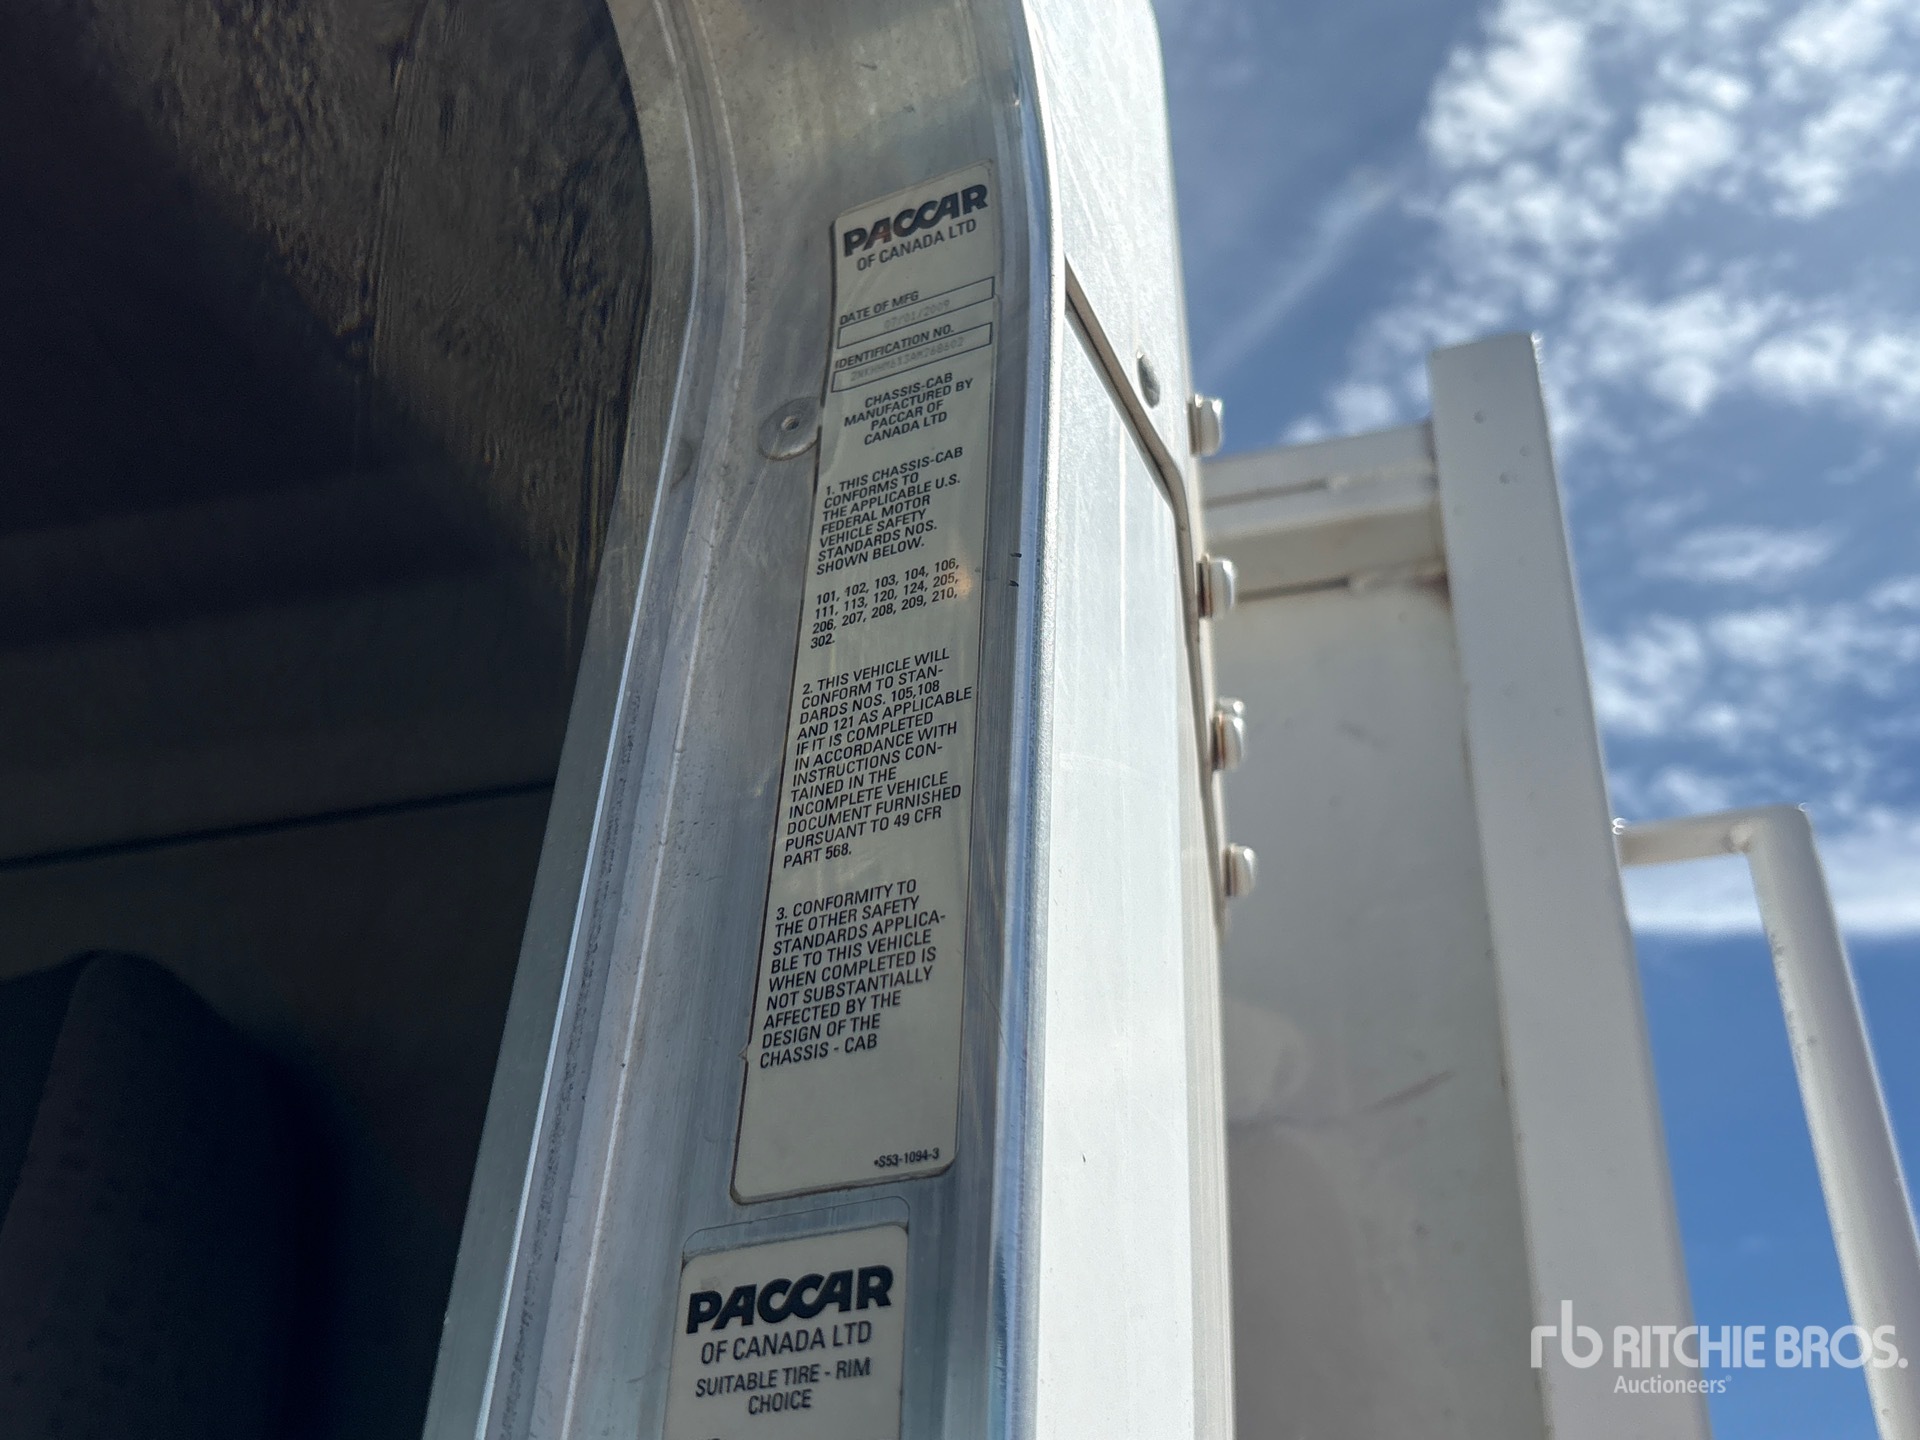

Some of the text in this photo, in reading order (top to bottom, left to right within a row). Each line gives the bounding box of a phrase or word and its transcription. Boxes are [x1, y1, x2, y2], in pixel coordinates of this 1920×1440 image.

[843, 184, 988, 258] PACCAR
[857, 219, 977, 271] OF CANADA LTD
[840, 291, 919, 325] DATE OF MFG
[835, 324, 954, 369] IDENTIFICATION NO.
[844, 378, 974, 427] MANUFACTURED BY
[865, 372, 953, 408] CHASSIS-CAB
[864, 411, 947, 446] CANADA LTD
[870, 399, 945, 431] PACCAR OF
[824, 472, 920, 509] CONFORMS TO
[826, 447, 963, 496] 1. THIS CHASSIS-CAB
[820, 495, 931, 535] FEDERAL MOTOR
[822, 473, 960, 522] THE APPLICABLE U.S.
[818, 520, 938, 562] STANDARDS NOS.
[820, 508, 927, 548] VEHICLE SAFETY
[816, 536, 925, 575] SHOWN BELOW.
[815, 572, 959, 619] 111, 113, 120, 124, 205,
[816, 558, 959, 605] 101, 102, 103, 104, 106,
[812, 586, 958, 634] 206, 207, 208, 209, 210,
[810, 634, 835, 650] 302.
[802, 648, 949, 695] 2. THIS VEHICLE WILL
[802, 665, 943, 709] CONFORM TO STAN-
[797, 687, 972, 740] AND 121 AS APPLICABLE
[800, 680, 940, 724] DARDS NOS. 105,108
[795, 721, 957, 771] IN ACCORDANCE WITH
[796, 712, 933, 756] IF IT IS COMPLETED
[791, 766, 897, 802] TAINED IN THE
[793, 741, 943, 787] INSTRUCTIONS CON-
[787, 784, 961, 835] DOCUMENT FURNISHED
[789, 771, 949, 819] INCOMPLETE VEHICLE
[785, 805, 942, 852] PURSUANT TO 49 CFR
[783, 843, 852, 869] PART 568.
[775, 896, 919, 938] THE OTHER SAFETY
[776, 879, 917, 921] 3. CONFORMITY TO
[771, 929, 932, 975] BLE TO THIS VEHICLE
[773, 910, 946, 956] STANDARDS APPLICA-
[766, 966, 934, 1011] NOT SUBSTANTIALLY
[769, 947, 937, 993] WHEN COMPLETED IS
[762, 1013, 881, 1050] DESIGN OF THE
[763, 990, 901, 1030] AFFECTED BY THE
[760, 1041, 828, 1069] CHASSIS
[844, 1034, 878, 1054] CAB
[686, 1264, 894, 1334] PACCAR
[701, 1320, 872, 1365] OF CANADA LTD
[695, 1370, 778, 1398] SUITABLE
[782, 1364, 820, 1385] TIRE
[836, 1357, 871, 1380] RIM
[748, 1389, 812, 1415] CHOICE
